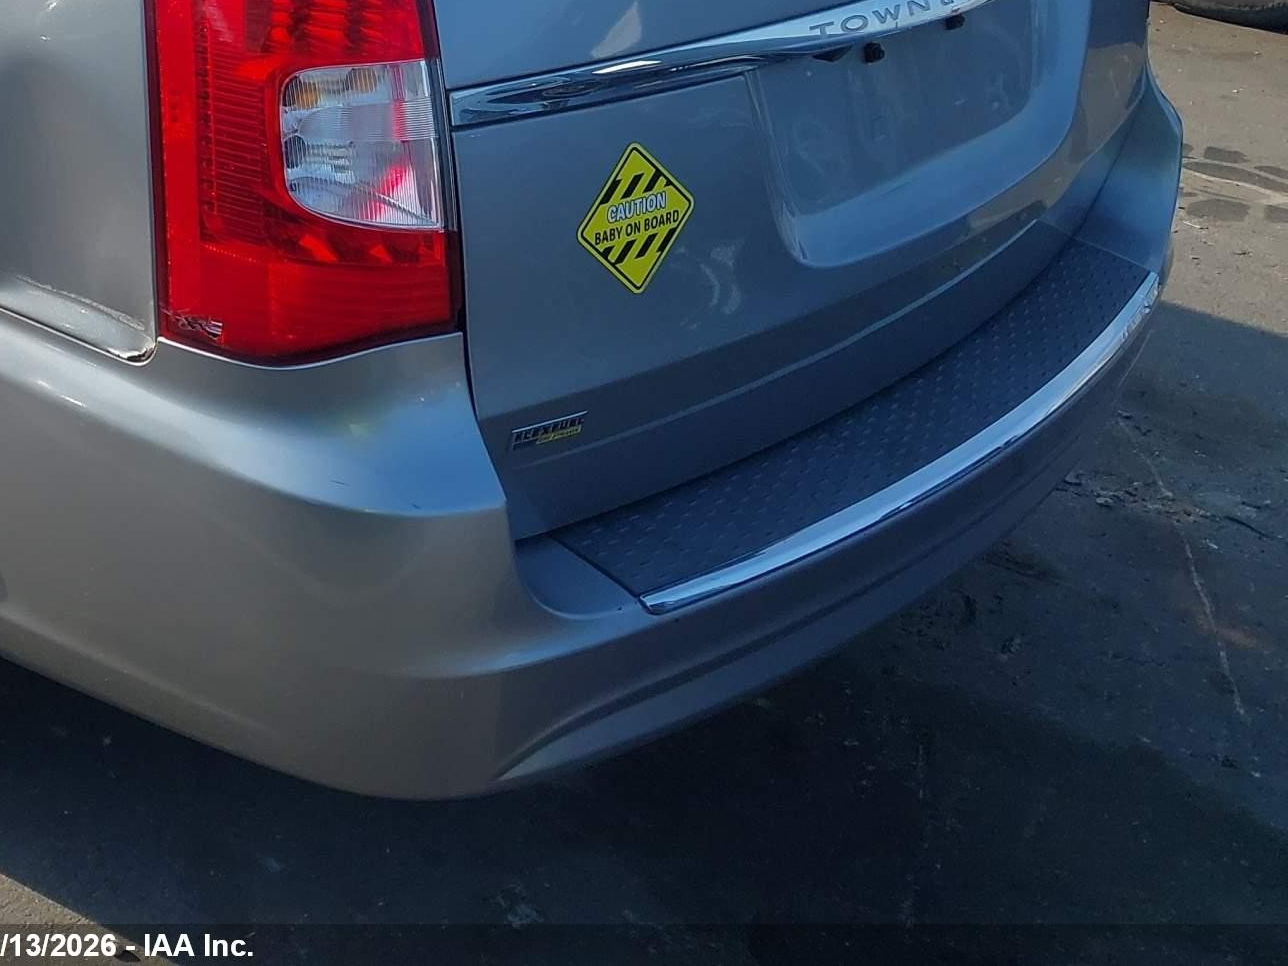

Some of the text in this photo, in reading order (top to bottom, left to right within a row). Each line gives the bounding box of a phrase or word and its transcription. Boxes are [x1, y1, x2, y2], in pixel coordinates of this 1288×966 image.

[608, 191, 667, 223] CAUTION
[595, 210, 679, 246] BABY ON BOARD
